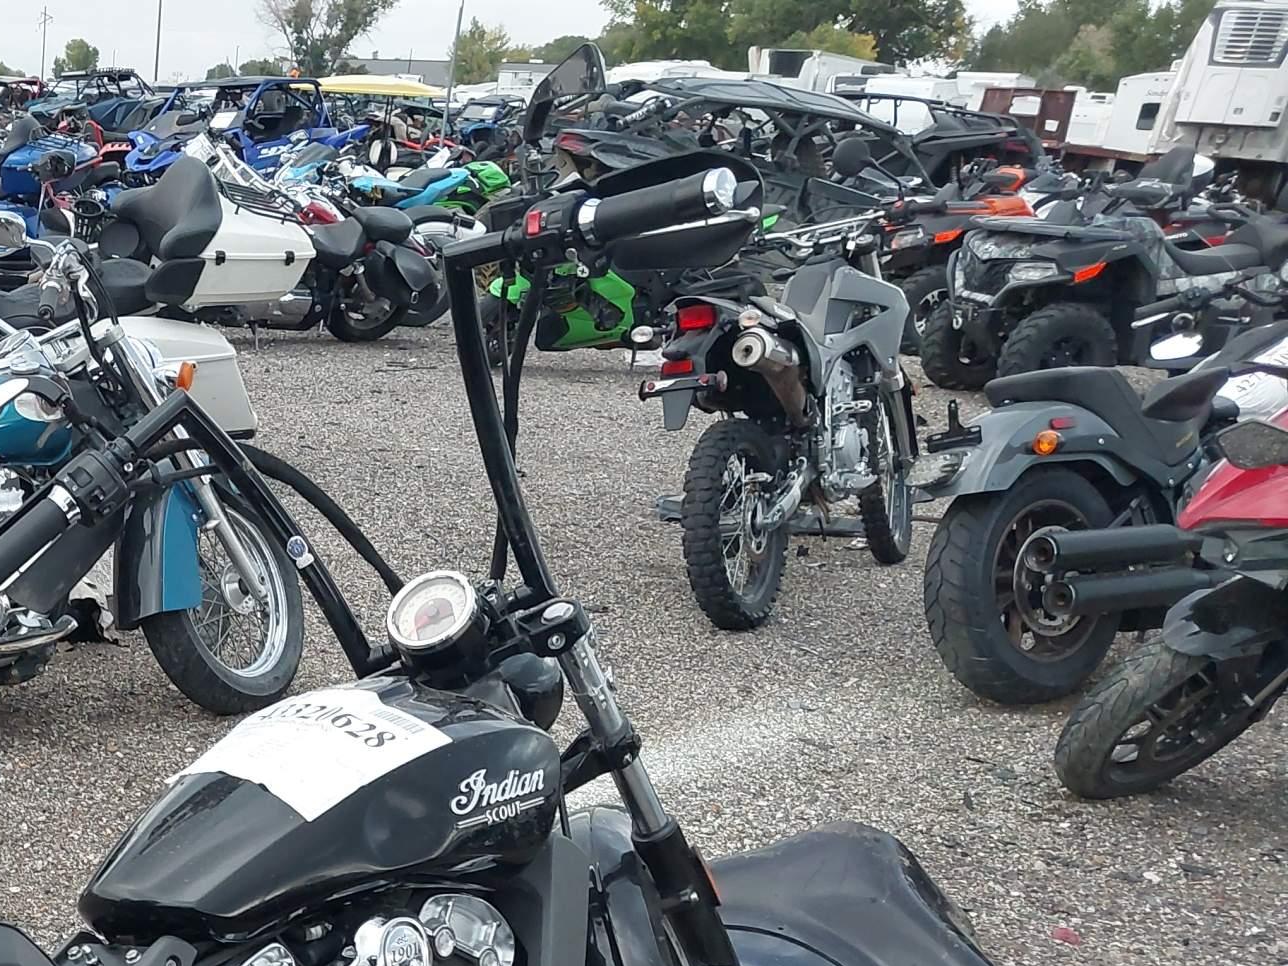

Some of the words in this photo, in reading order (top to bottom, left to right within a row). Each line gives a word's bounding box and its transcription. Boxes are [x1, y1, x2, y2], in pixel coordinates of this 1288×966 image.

[451, 768, 544, 815] Indian
[486, 801, 521, 826] SCOUT
[391, 942, 420, 963] 1901
